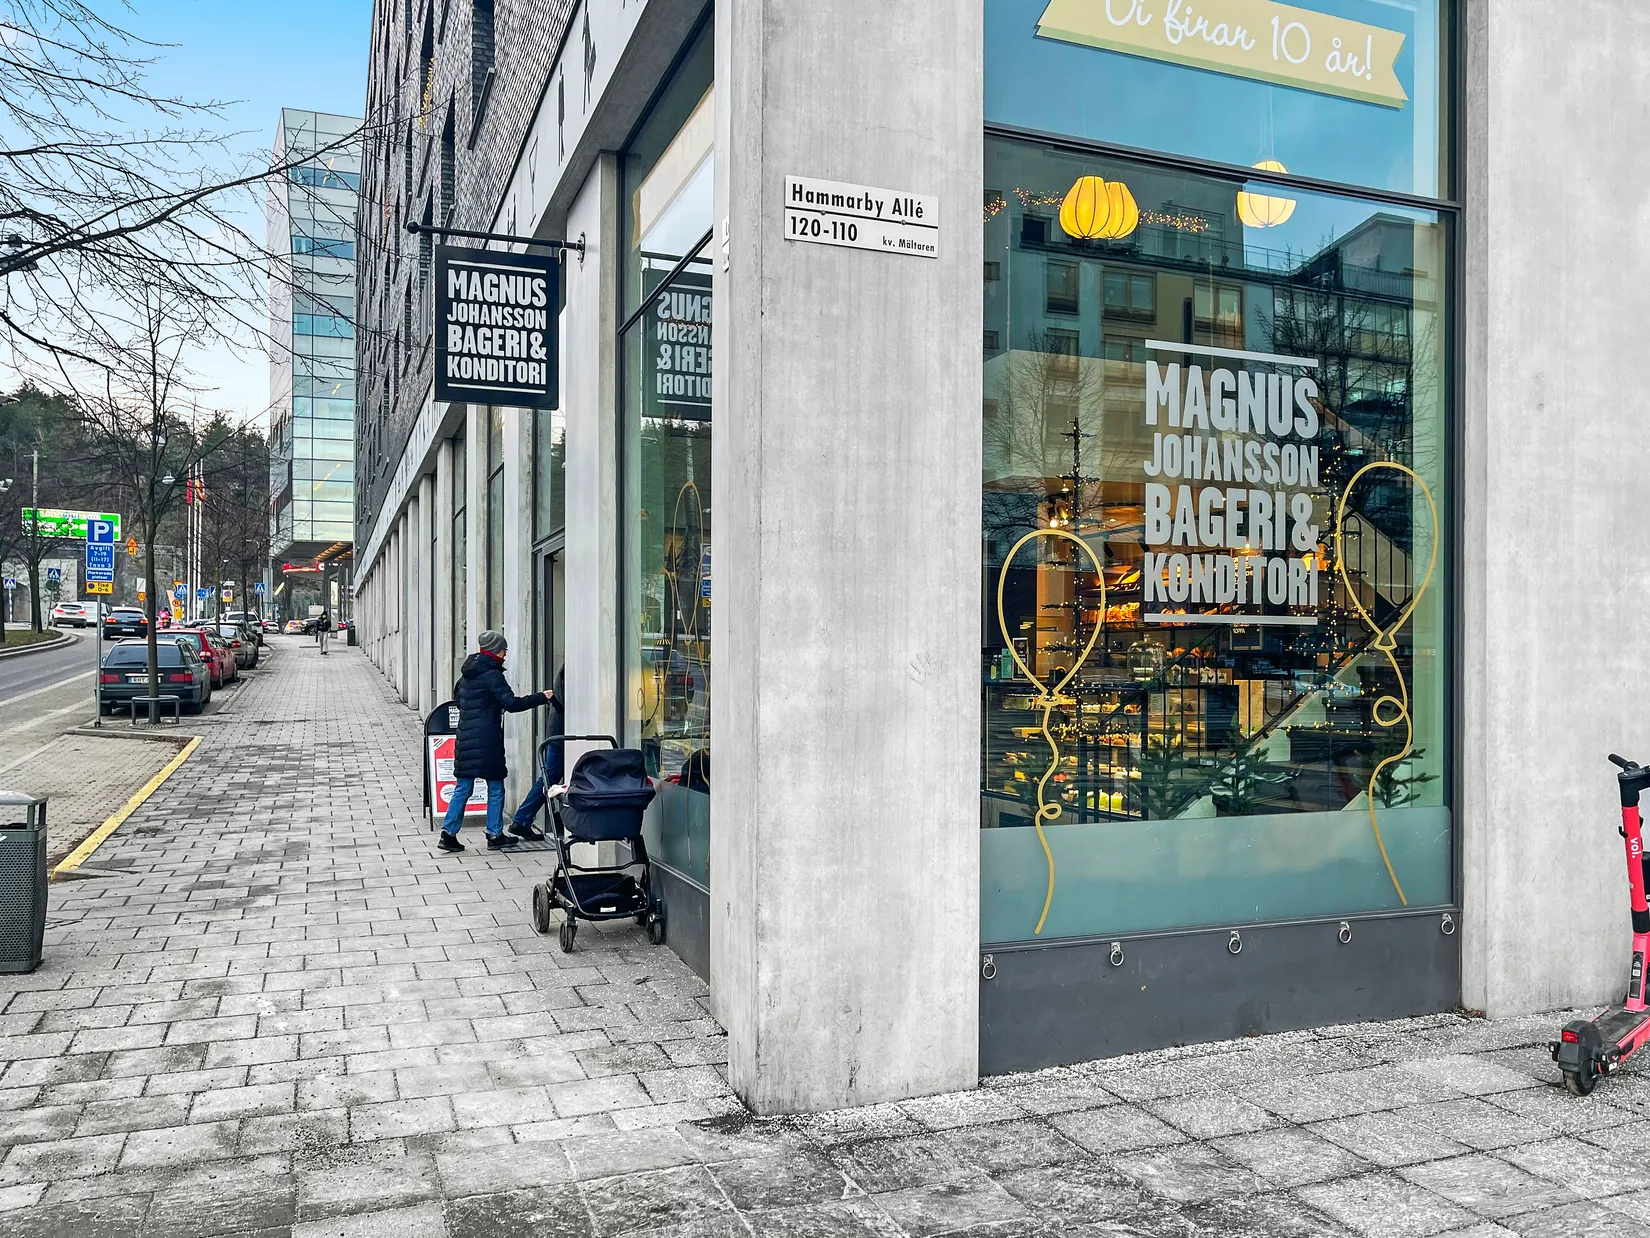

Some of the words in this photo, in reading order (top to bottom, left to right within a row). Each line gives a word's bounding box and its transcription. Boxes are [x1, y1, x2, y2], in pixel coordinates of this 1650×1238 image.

[1164, 0, 1255, 51] firar
[1271, 14, 1312, 64] 10
[1325, 34, 1373, 81] år!
[792, 183, 884, 217] Hammarby
[891, 197, 924, 219] Allé
[790, 216, 858, 242] 120-110
[882, 235, 896, 247] kv.
[898, 238, 935, 253] Mältaren
[447, 269, 547, 307] MAGNUS
[447, 301, 547, 330] JOHANSSON
[447, 324, 528, 359] BAGERI
[530, 332, 547, 360] &
[447, 355, 547, 385] KONDITORI
[1145, 360, 1319, 439] MAGNUS
[1143, 432, 1319, 488] JOHANSSON
[94, 521, 110, 541] P
[1145, 482, 1286, 551] BAGERI
[1291, 492, 1320, 553] &
[1144, 551, 1318, 606] KONDITORI
